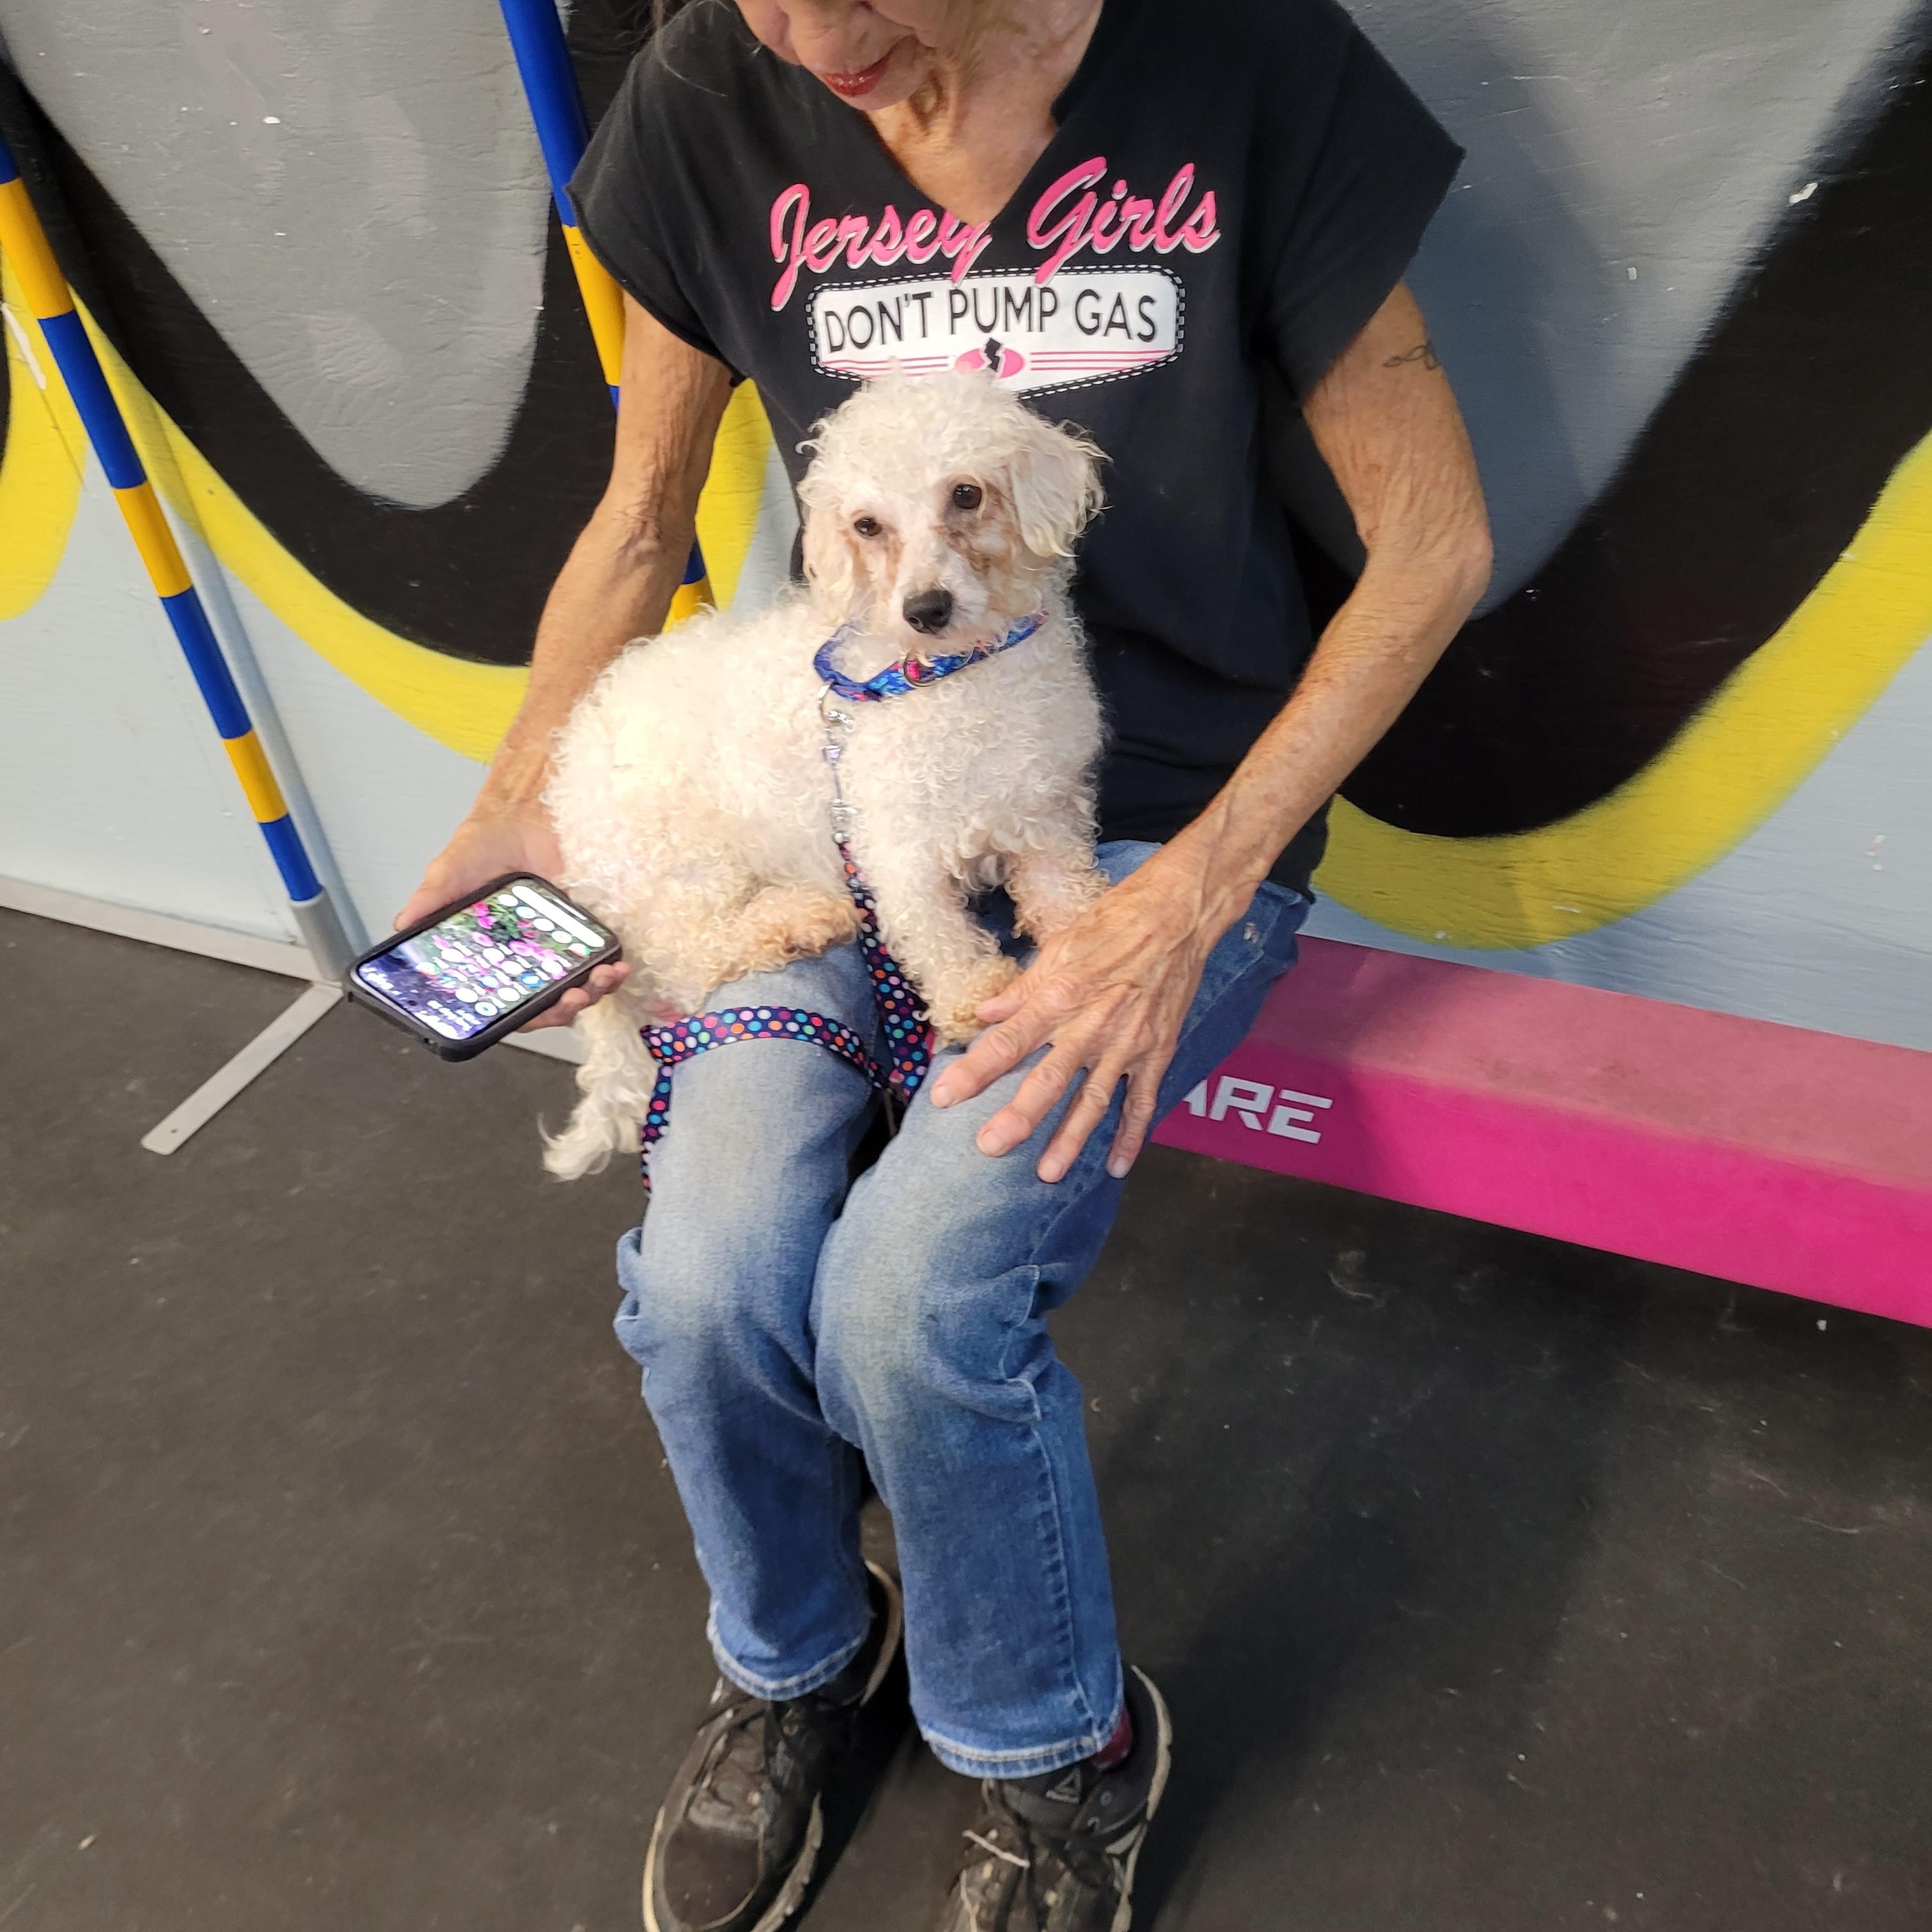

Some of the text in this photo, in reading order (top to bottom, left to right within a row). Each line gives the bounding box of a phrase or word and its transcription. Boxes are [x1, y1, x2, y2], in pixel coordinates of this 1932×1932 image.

[770, 156, 1221, 311] Jersey Girls
[824, 286, 1157, 353] DON'T PUMP GAS
